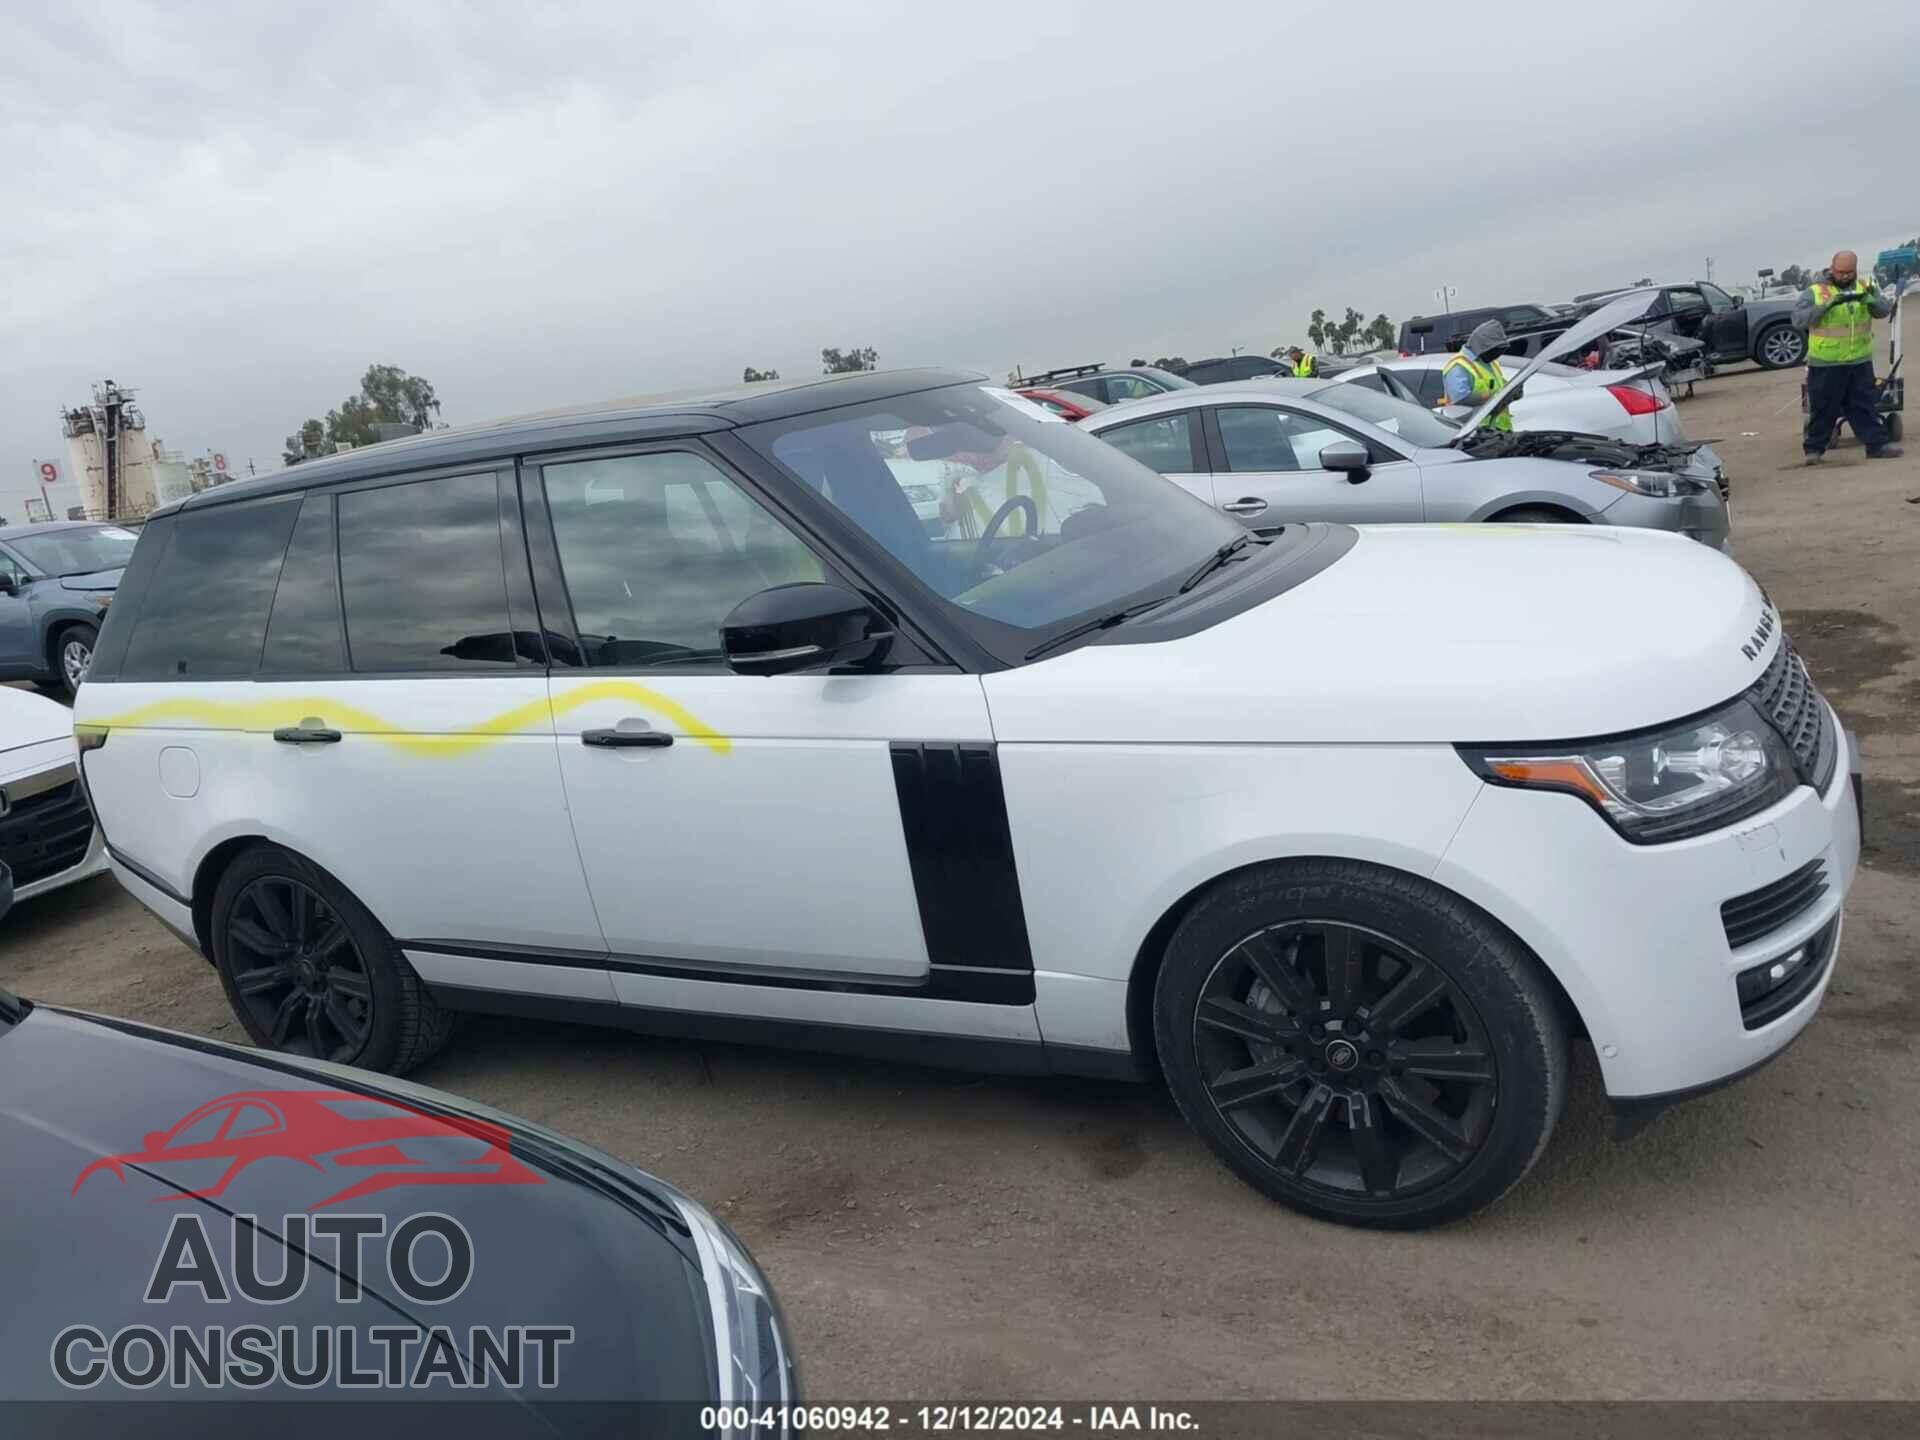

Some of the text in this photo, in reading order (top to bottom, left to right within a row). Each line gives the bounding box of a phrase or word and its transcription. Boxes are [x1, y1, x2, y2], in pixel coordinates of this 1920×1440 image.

[214, 453, 226, 471] 8
[41, 463, 57, 482] 9
[1741, 608, 1774, 662] RANGE
